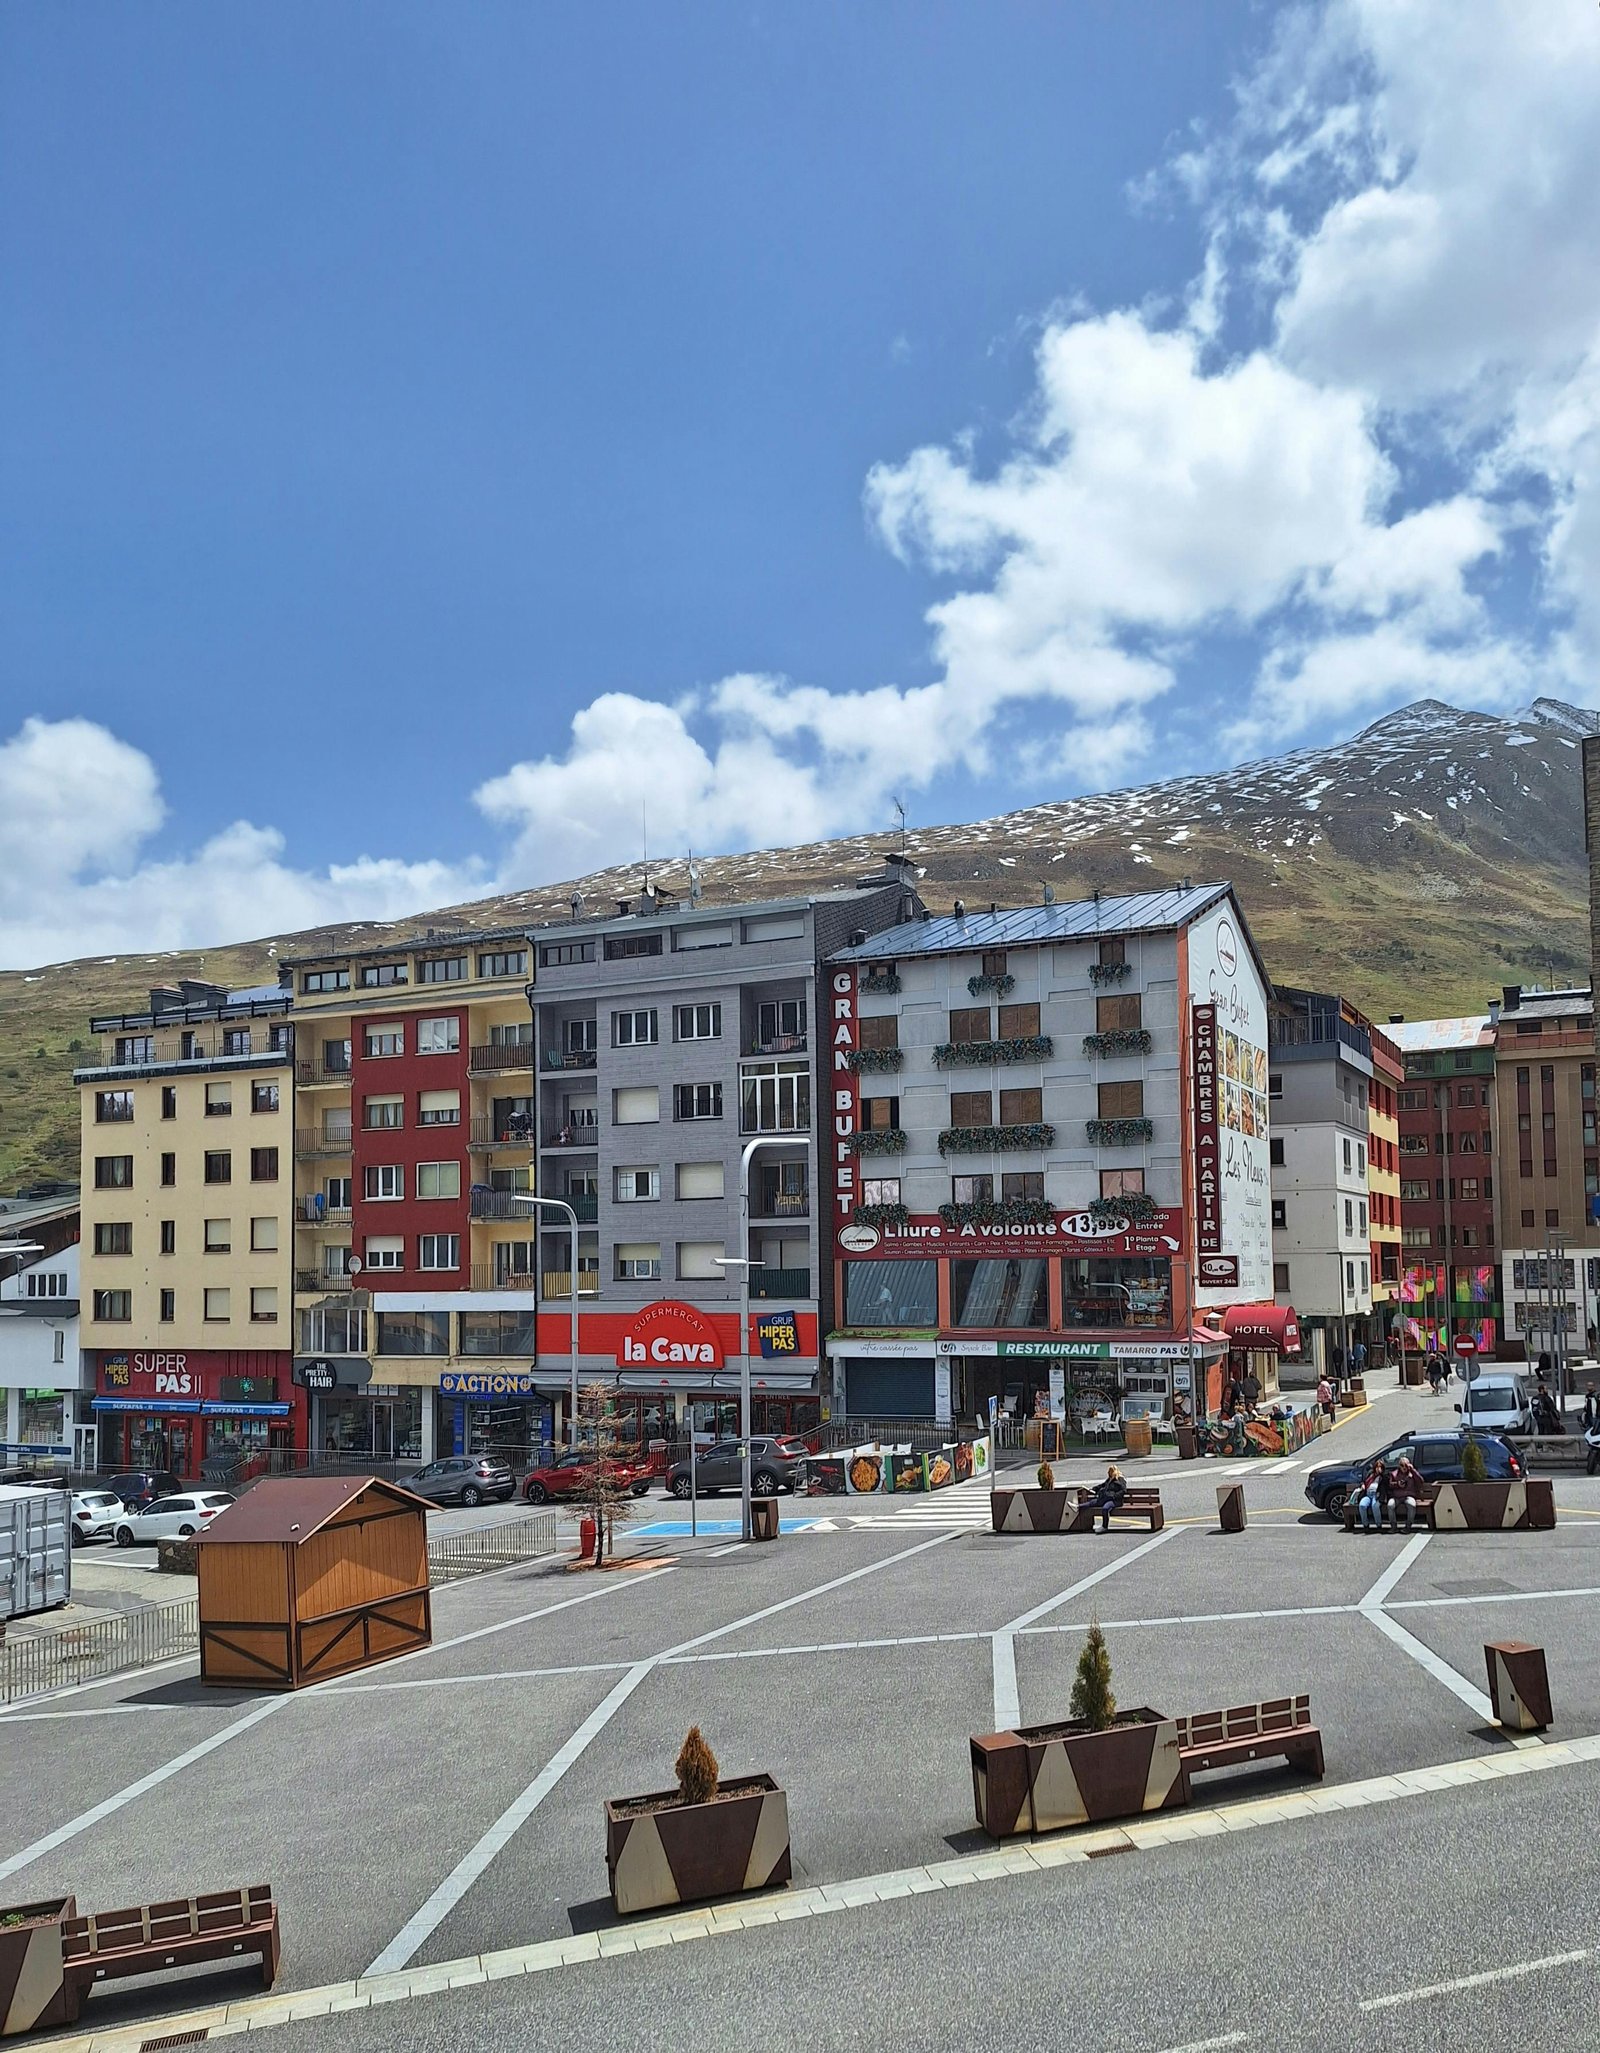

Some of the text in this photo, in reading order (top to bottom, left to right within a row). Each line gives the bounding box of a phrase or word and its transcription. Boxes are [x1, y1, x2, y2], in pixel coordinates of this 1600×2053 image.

[833, 972, 854, 1214] GRAN BUFET
[1197, 1025, 1218, 1247] CHAMBRES A PARTIR DE
[1135, 1222, 1164, 1230] Entrée
[634, 1307, 704, 1332] SUPERMERCAT
[771, 1316, 793, 1325] GRUP
[759, 1325, 794, 1338] HIPER
[1234, 1326, 1273, 1334] HOTEL
[624, 1336, 714, 1362] la Cava
[772, 1337, 795, 1350] PAS
[1005, 1343, 1101, 1355] RESTAURANT
[1113, 1346, 1158, 1354] TAMARRO
[104, 1364, 129, 1374] HIPER
[133, 1353, 187, 1373] SUPER
[316, 1362, 327, 1370] THE
[305, 1369, 328, 1377] PRETTY
[113, 1374, 129, 1385] PAS
[155, 1373, 192, 1394] PAS
[309, 1376, 333, 1388] HAIR
[456, 1375, 518, 1393] ACTION
